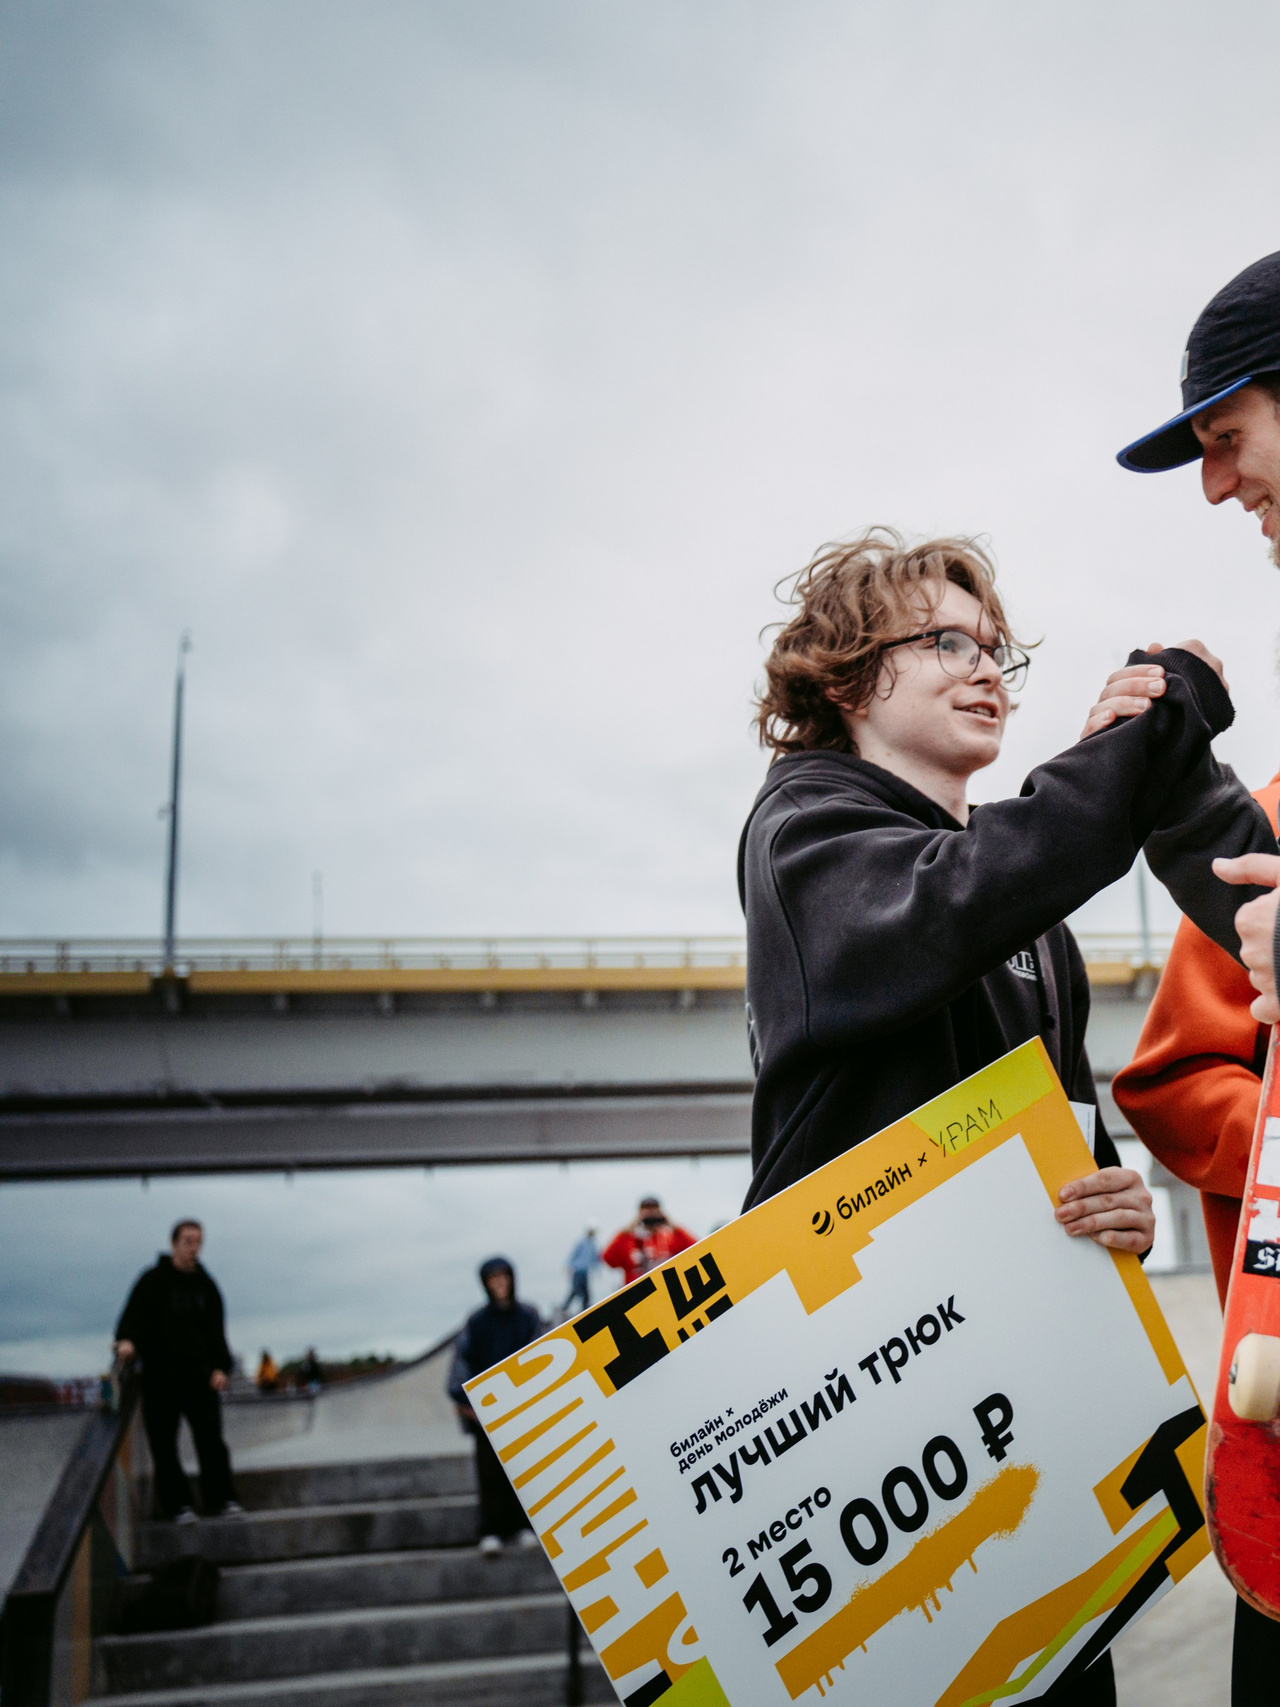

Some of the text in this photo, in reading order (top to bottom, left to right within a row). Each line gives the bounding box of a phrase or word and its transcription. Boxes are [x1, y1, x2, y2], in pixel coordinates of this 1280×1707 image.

[836, 1162, 913, 1220] билайн
[669, 1414, 725, 1459] билайн
[677, 1387, 790, 1474] день молодёжи
[690, 1367, 857, 1515] лучший
[857, 1294, 966, 1385] трюк
[722, 1486, 832, 1578] 2 место
[742, 1537, 833, 1648] 15
[839, 1434, 969, 1567] 000
